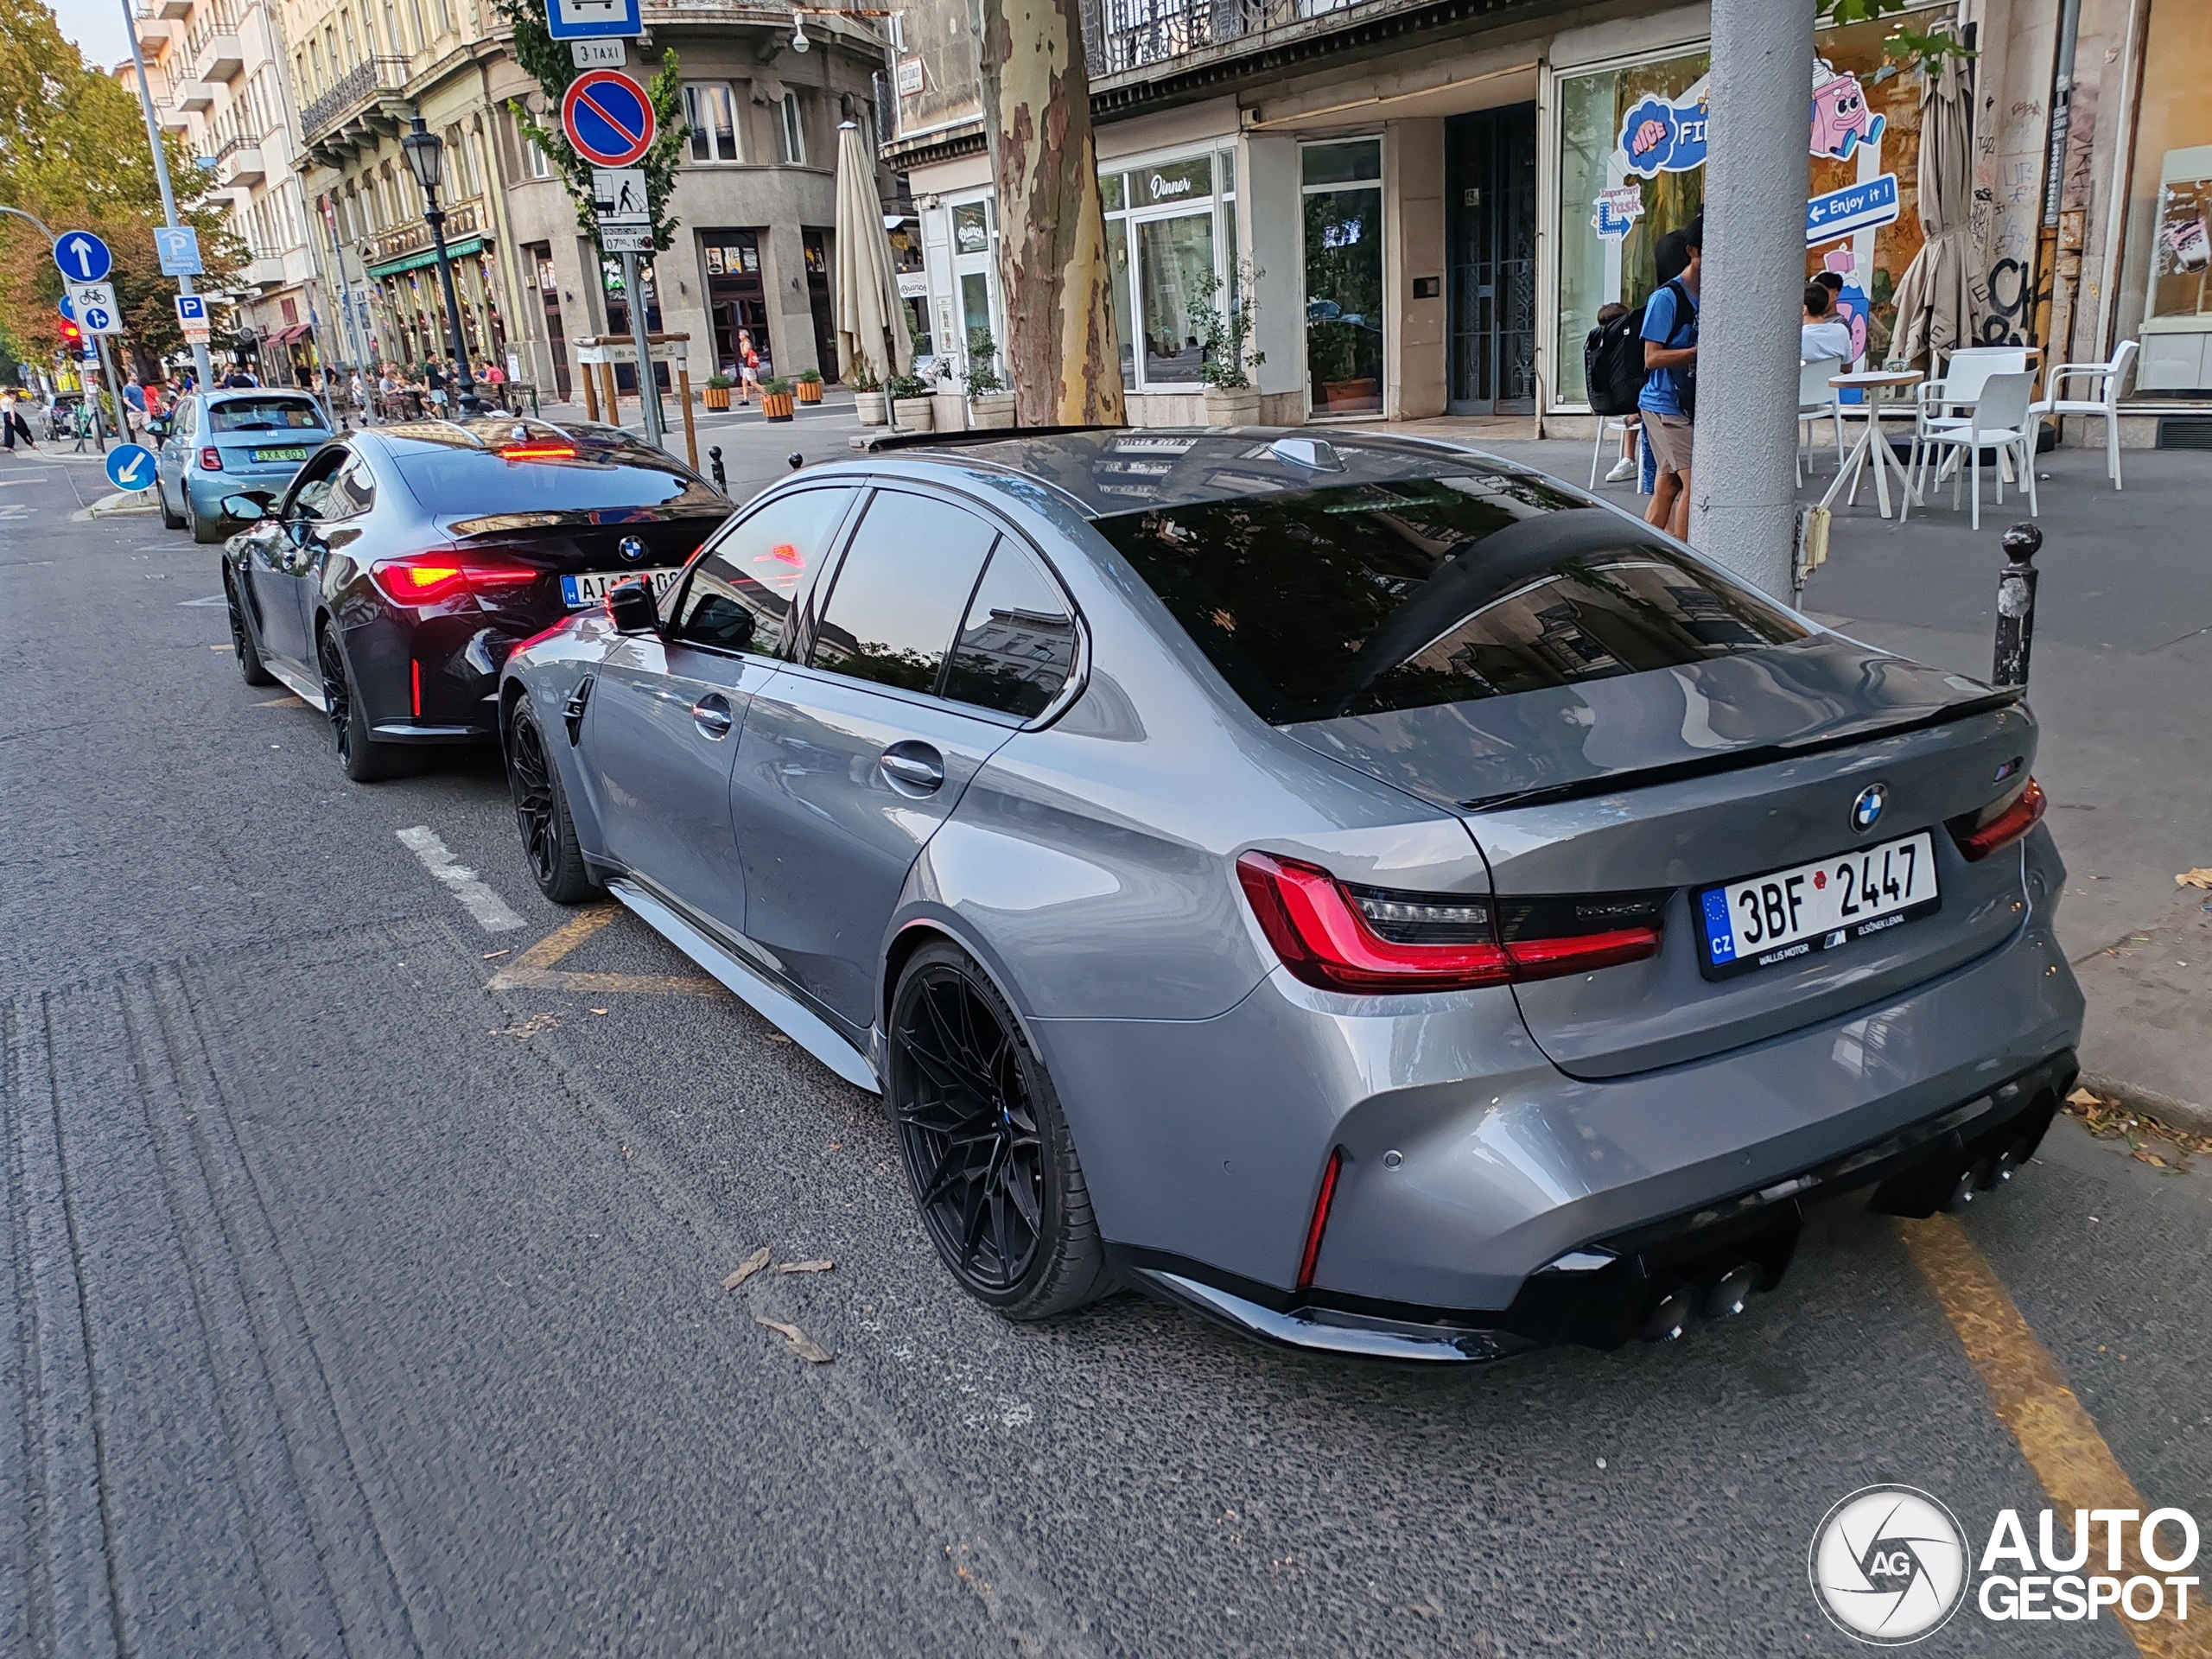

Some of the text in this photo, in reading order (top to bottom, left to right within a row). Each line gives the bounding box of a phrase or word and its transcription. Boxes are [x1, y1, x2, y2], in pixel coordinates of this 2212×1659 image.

[580, 46, 619, 62] 3 TAXI
[1632, 121, 1668, 156] NICE
[1150, 174, 1191, 200] Dinner
[1600, 188, 1639, 200] Important
[1609, 196, 1640, 214] task
[1829, 195, 1865, 215] Enjoy
[1869, 188, 1880, 202] it
[449, 211, 473, 235] PUB
[958, 226, 985, 244] Brunch
[900, 283, 927, 296] Brunch
[183, 300, 199, 316] P
[257, 449, 305, 461] SXA-603
[568, 592, 576, 601] H
[1738, 843, 1916, 944] 3BF 2447
[1712, 935, 1732, 955] CZ
[1758, 943, 1810, 966] WALLIS MOTOR
